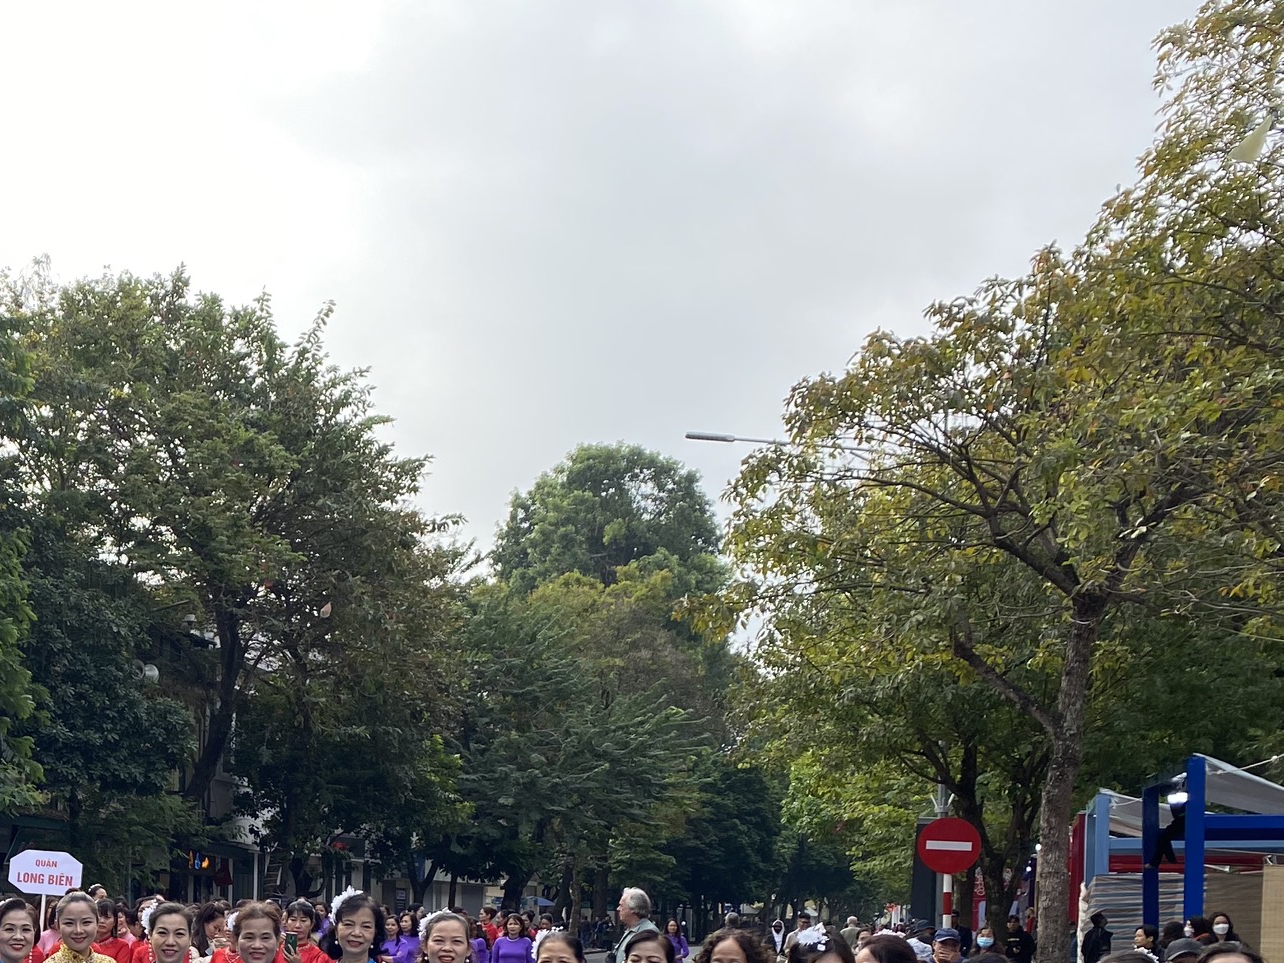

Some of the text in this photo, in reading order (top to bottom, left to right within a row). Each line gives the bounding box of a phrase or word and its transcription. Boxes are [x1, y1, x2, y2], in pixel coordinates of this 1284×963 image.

[35, 858, 58, 869] QUẬN
[17, 872, 73, 886] LONG BIÊN
